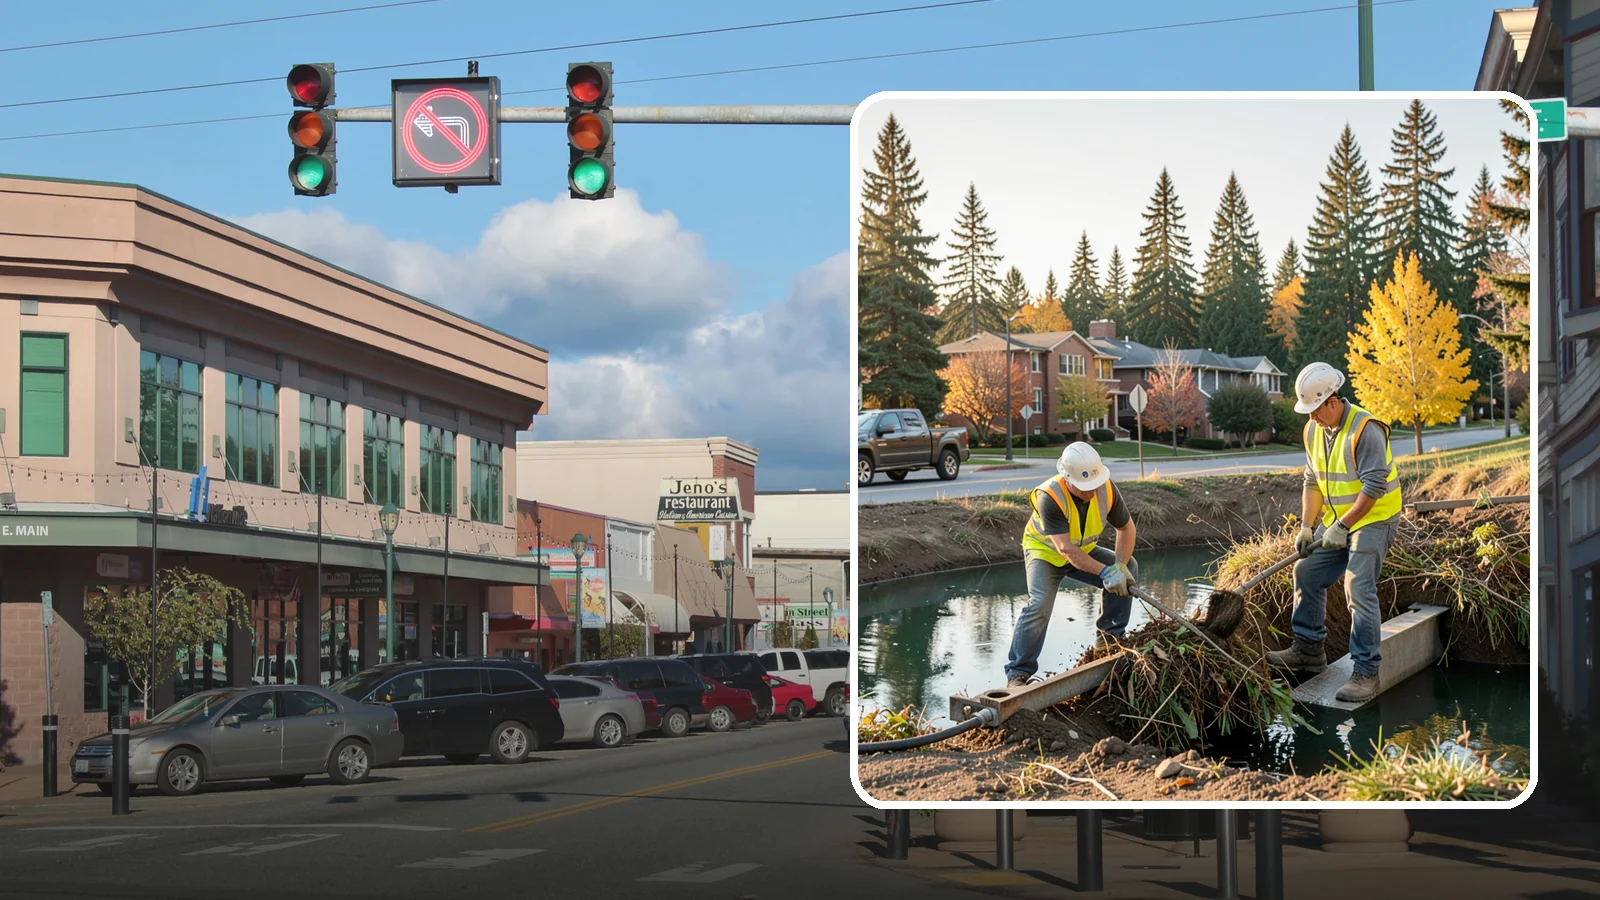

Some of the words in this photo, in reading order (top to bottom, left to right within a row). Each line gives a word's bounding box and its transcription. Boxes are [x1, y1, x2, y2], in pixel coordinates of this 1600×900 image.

[669, 480, 728, 495] Jeno's
[665, 496, 731, 509] restaurant
[658, 509, 682, 520] Italian
[685, 509, 715, 519] American
[715, 509, 737, 519] Cuisine
[2, 525, 13, 536] E.
[15, 525, 49, 536] MAIN
[797, 607, 828, 617] Street
[791, 619, 823, 627] lass
